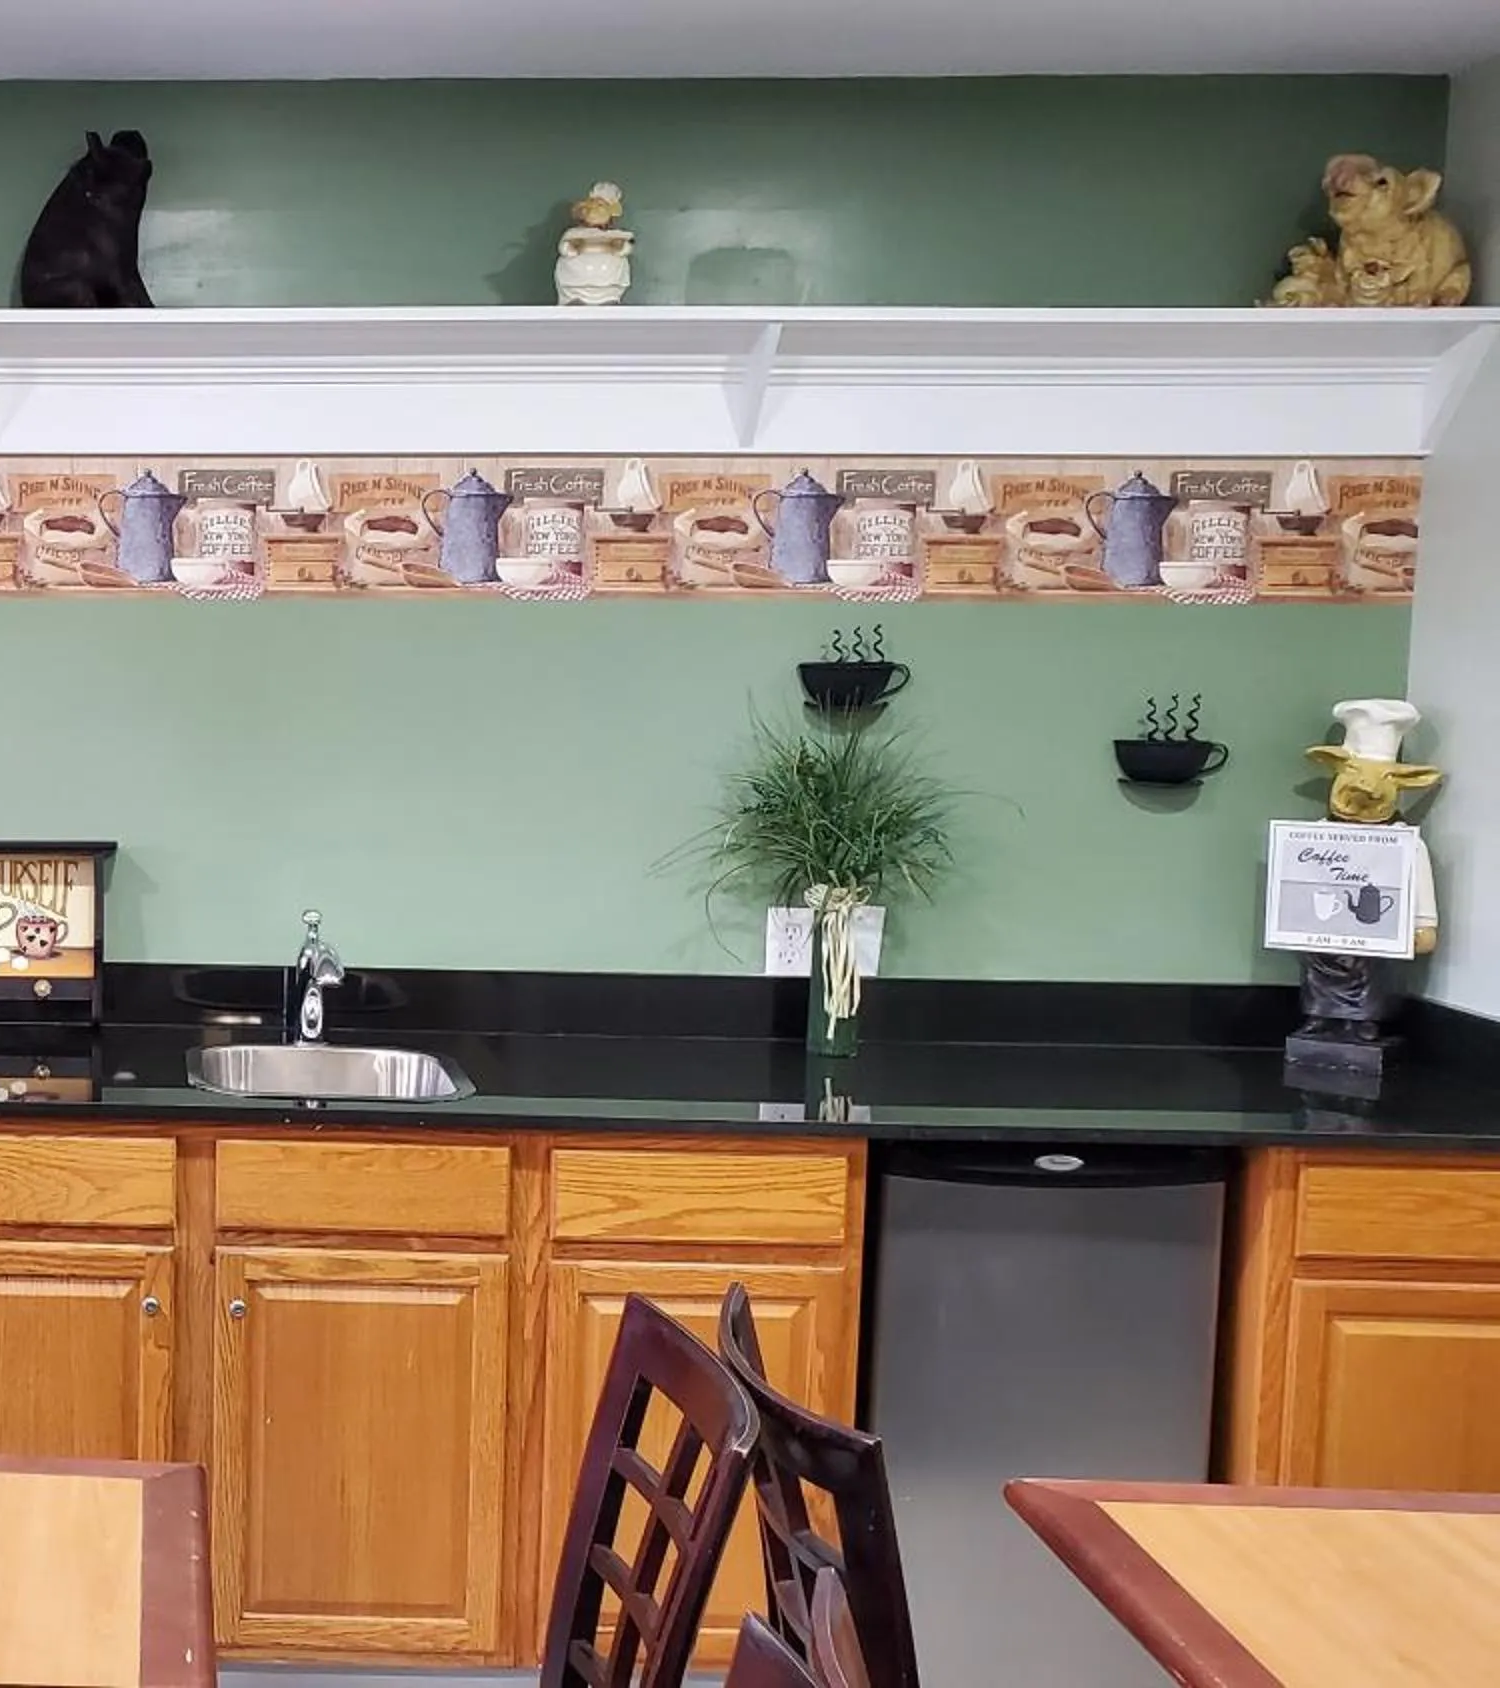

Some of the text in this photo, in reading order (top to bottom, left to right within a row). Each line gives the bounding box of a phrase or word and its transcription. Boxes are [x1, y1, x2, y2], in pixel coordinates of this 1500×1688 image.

[222, 475, 273, 496] Coffee
[550, 473, 602, 495] Coffee
[882, 474, 933, 496] Coffee
[1216, 477, 1269, 498] Coffee
[1368, 835, 1398, 844] FROM
[1297, 847, 1350, 866] Coffee
[1330, 867, 1370, 882] Time
